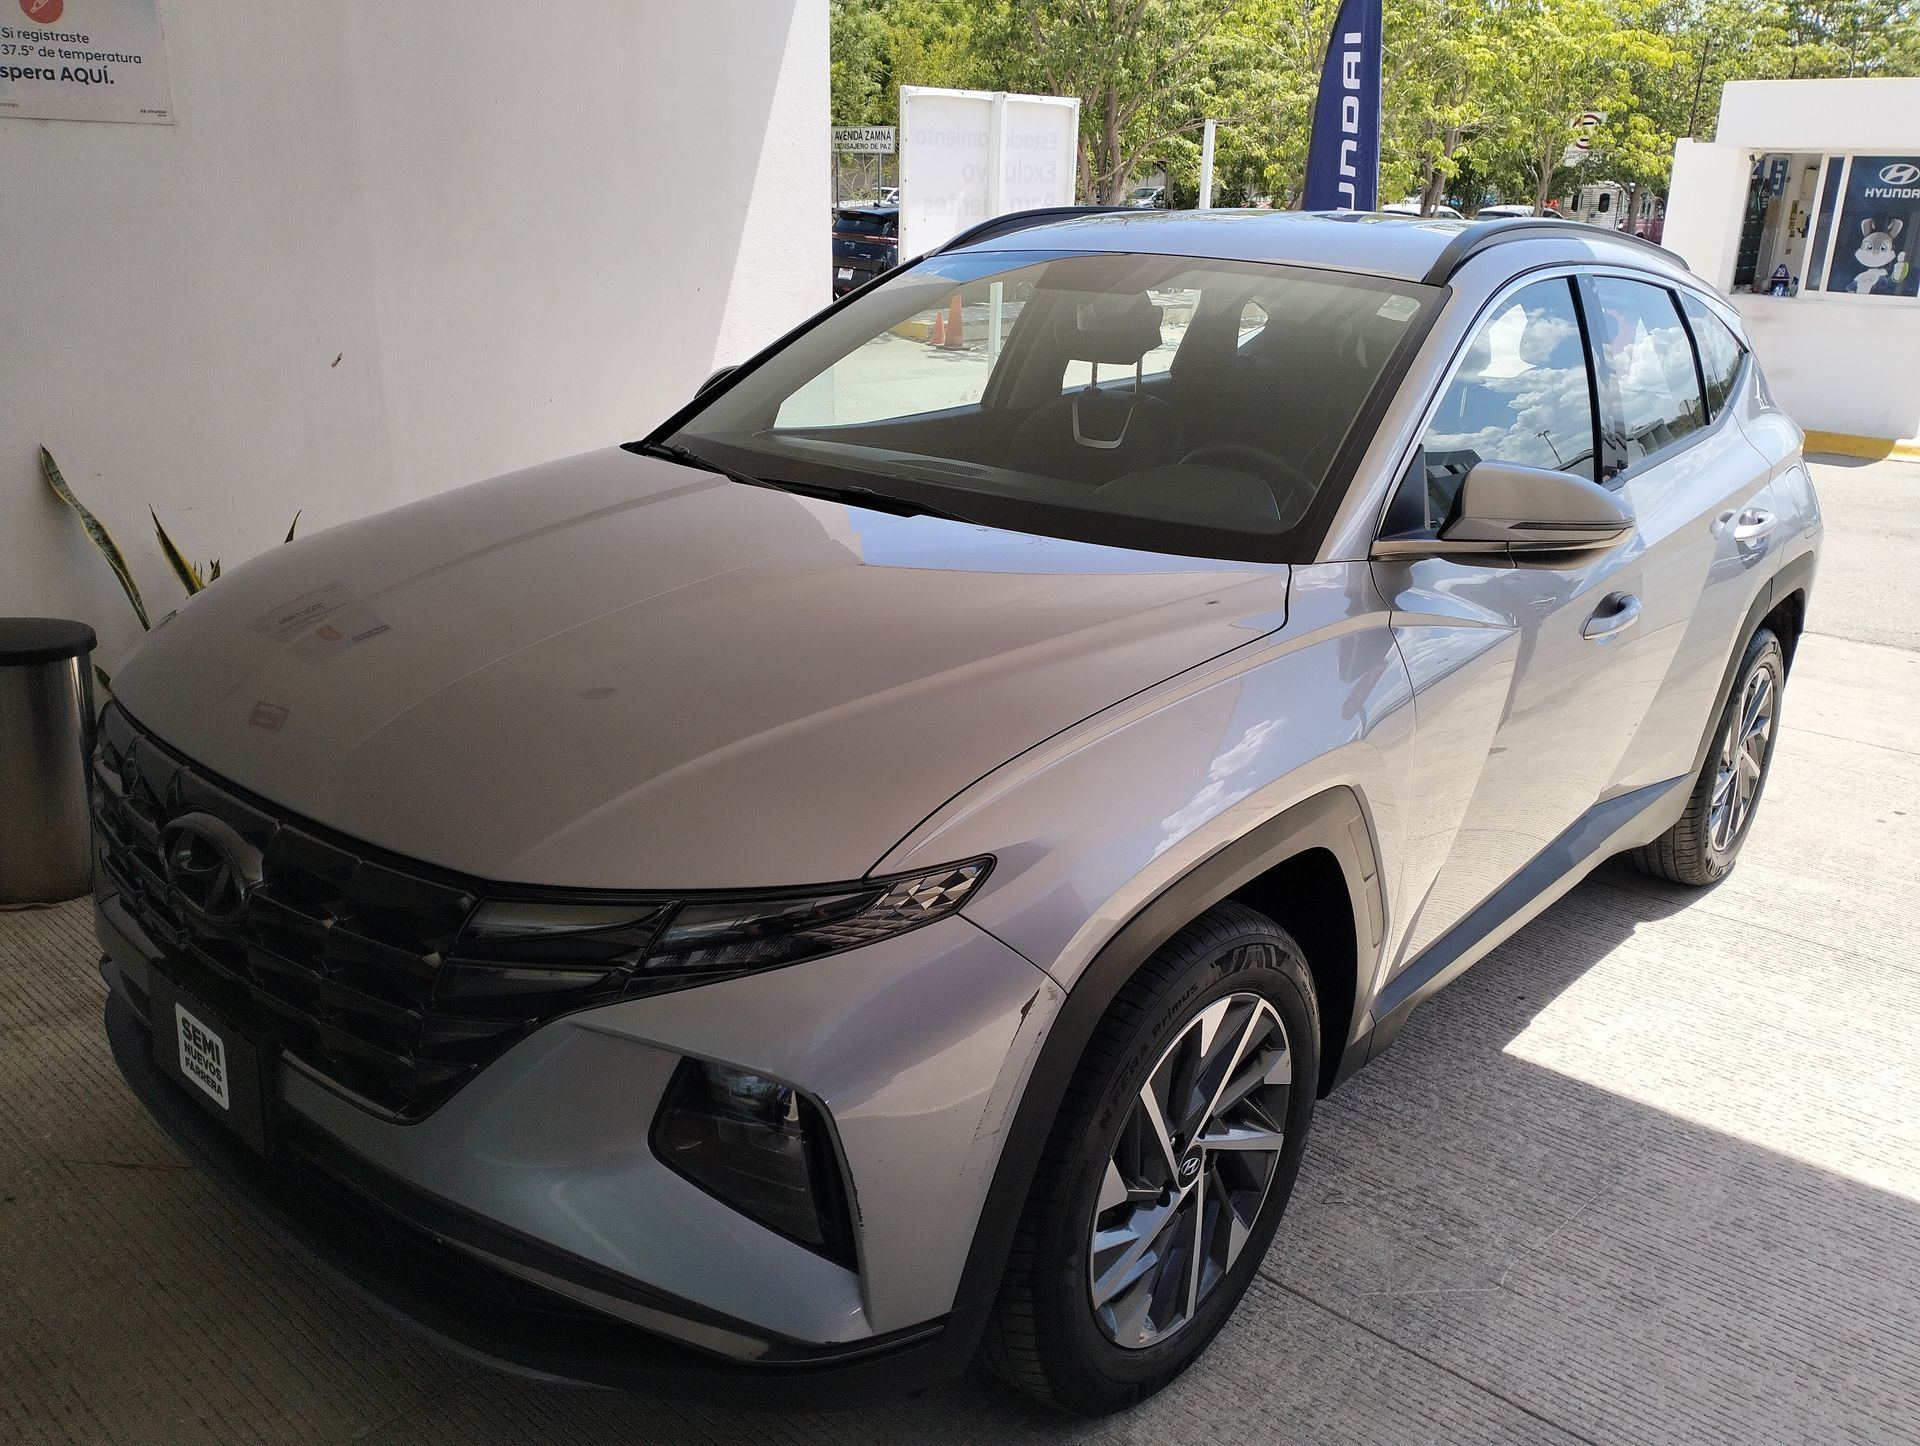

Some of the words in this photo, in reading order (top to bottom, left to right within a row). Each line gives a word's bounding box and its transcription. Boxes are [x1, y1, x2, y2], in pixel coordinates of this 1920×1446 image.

[1, 27, 13, 39] Si
[16, 29, 90, 44] registraste
[38, 47, 55, 59] de
[58, 48, 142, 64] temperatura
[60, 65, 115, 85] AQUÍ.
[181, 1016, 221, 1067] SEMI
[184, 1040, 222, 1082] NUEVOS
[185, 1056, 223, 1098] FARRERA
